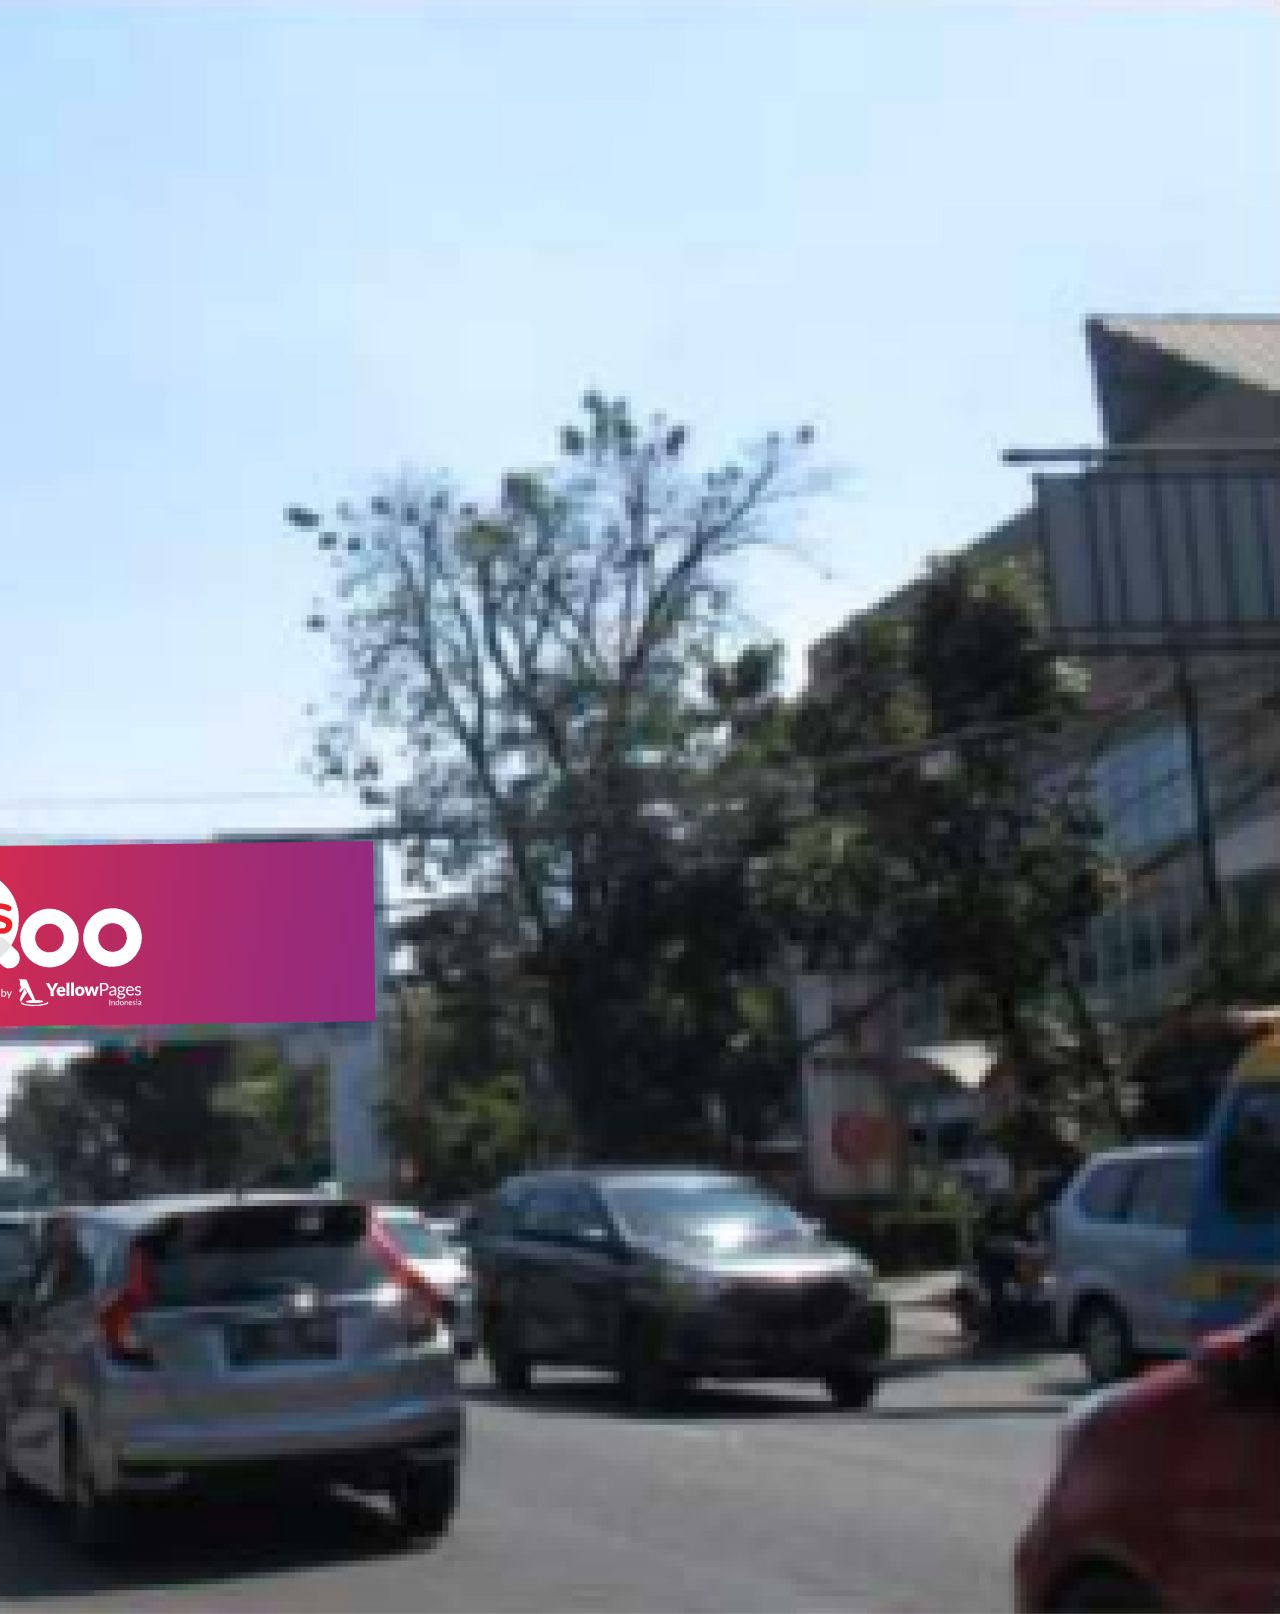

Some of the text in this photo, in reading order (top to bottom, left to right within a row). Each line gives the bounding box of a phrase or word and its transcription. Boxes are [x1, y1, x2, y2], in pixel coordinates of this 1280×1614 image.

[0, 982, 142, 999] by YellowPages
[108, 999, 142, 1007] Indonesia
